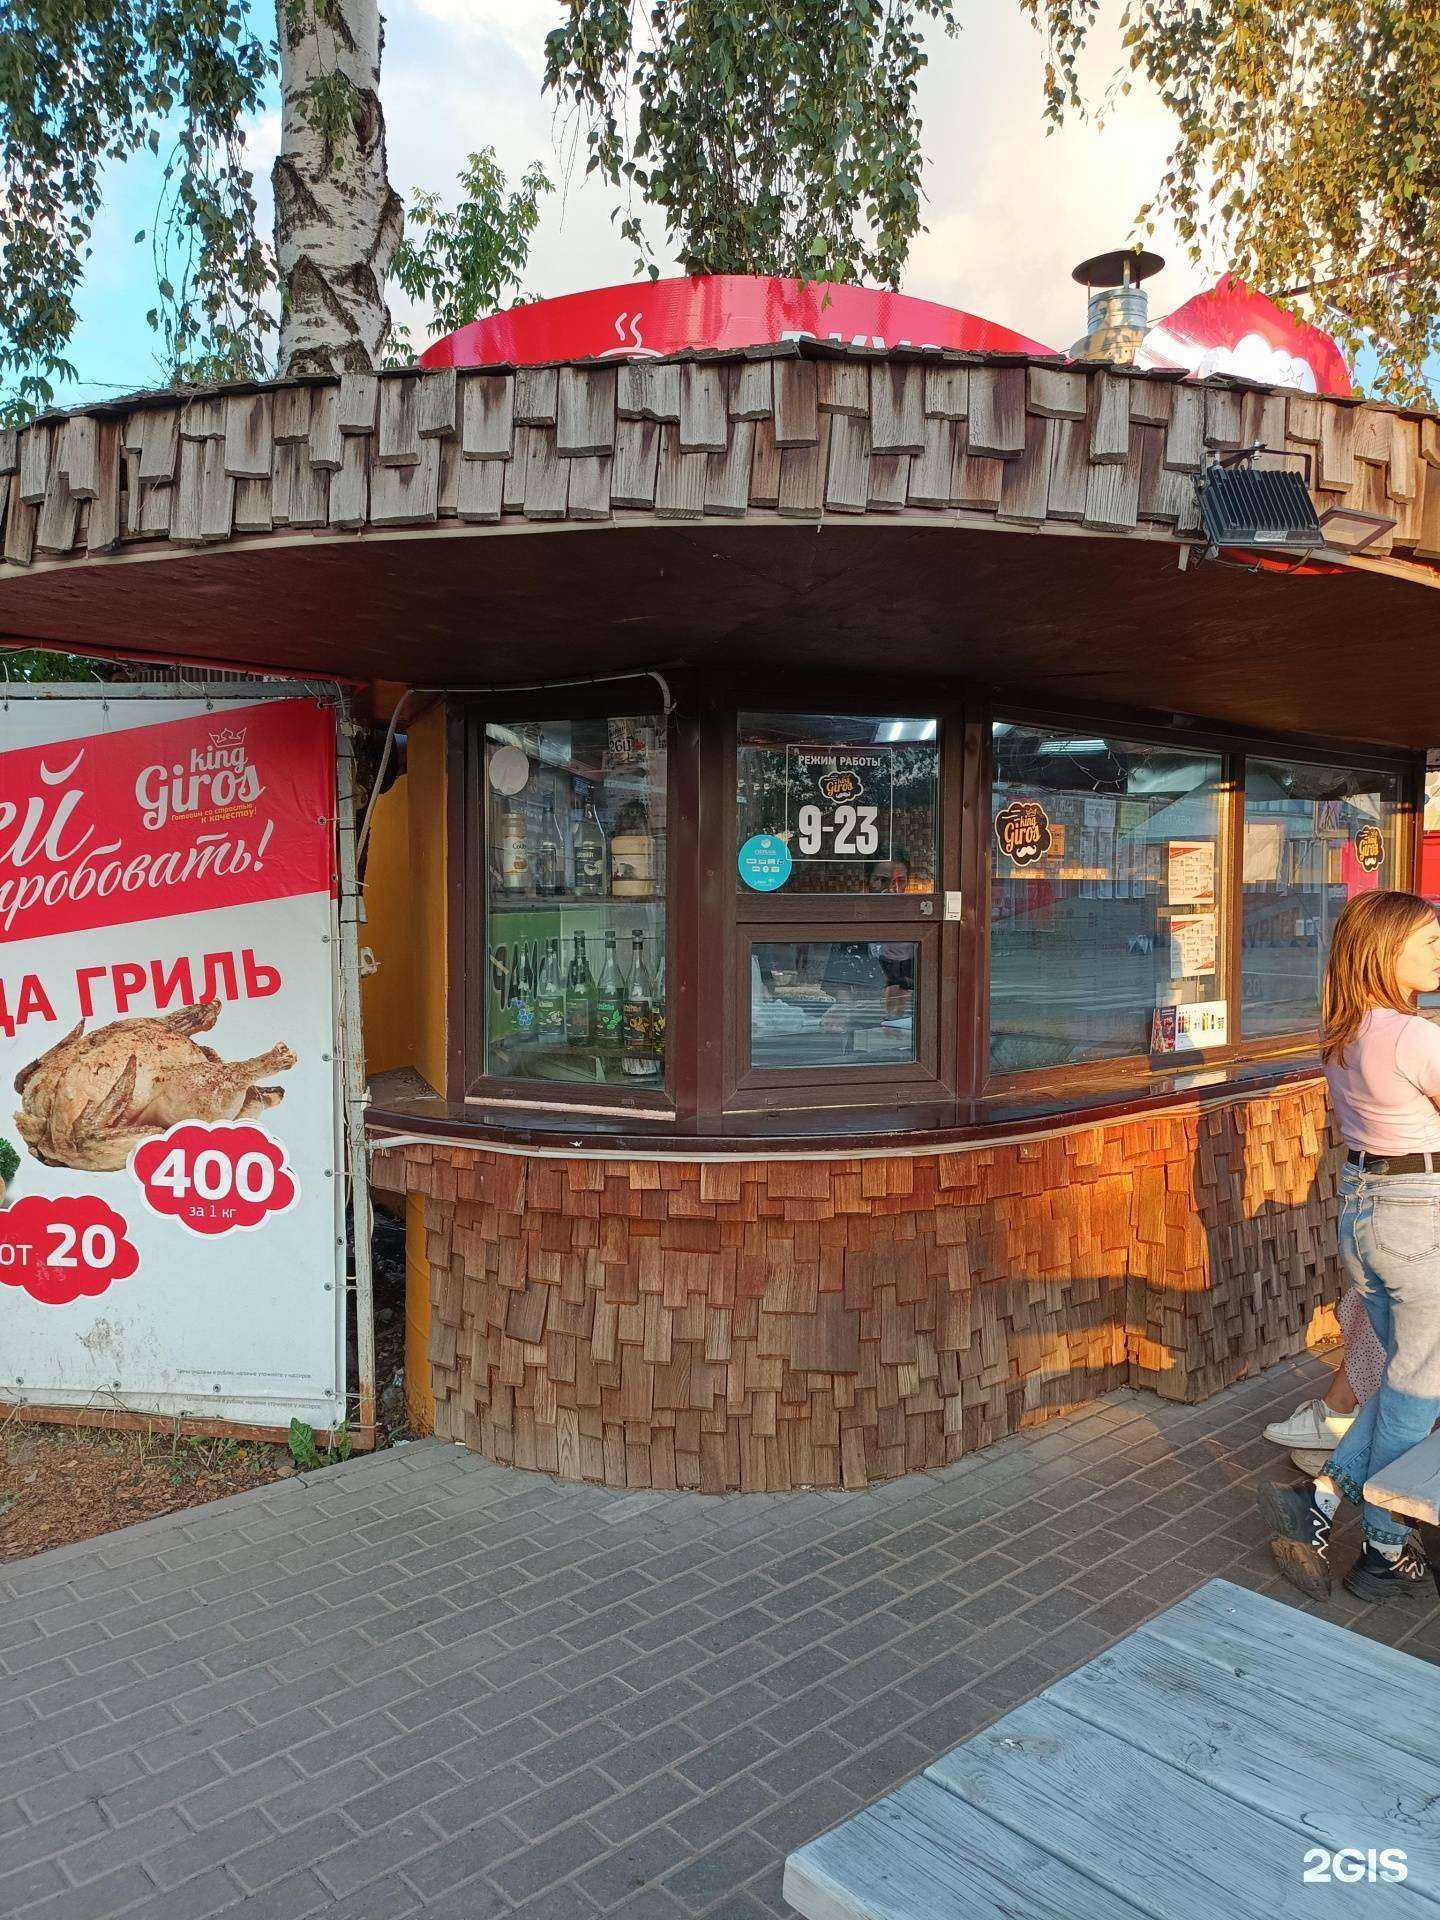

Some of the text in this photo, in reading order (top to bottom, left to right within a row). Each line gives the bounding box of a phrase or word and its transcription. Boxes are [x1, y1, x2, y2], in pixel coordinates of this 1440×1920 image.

[190, 745, 250, 772] king
[798, 754, 881, 767] РЕЖИМ РАБОТЫ
[135, 763, 267, 831] Giros
[798, 804, 879, 855] 9-23
[1006, 822, 1042, 853] Giros
[1020, 815, 1037, 828] king
[75, 948, 282, 1018] ГРИЛЬ
[150, 1148, 275, 1203] 400
[188, 1204, 237, 1219] за 1 кг
[46, 1223, 116, 1269] 20
